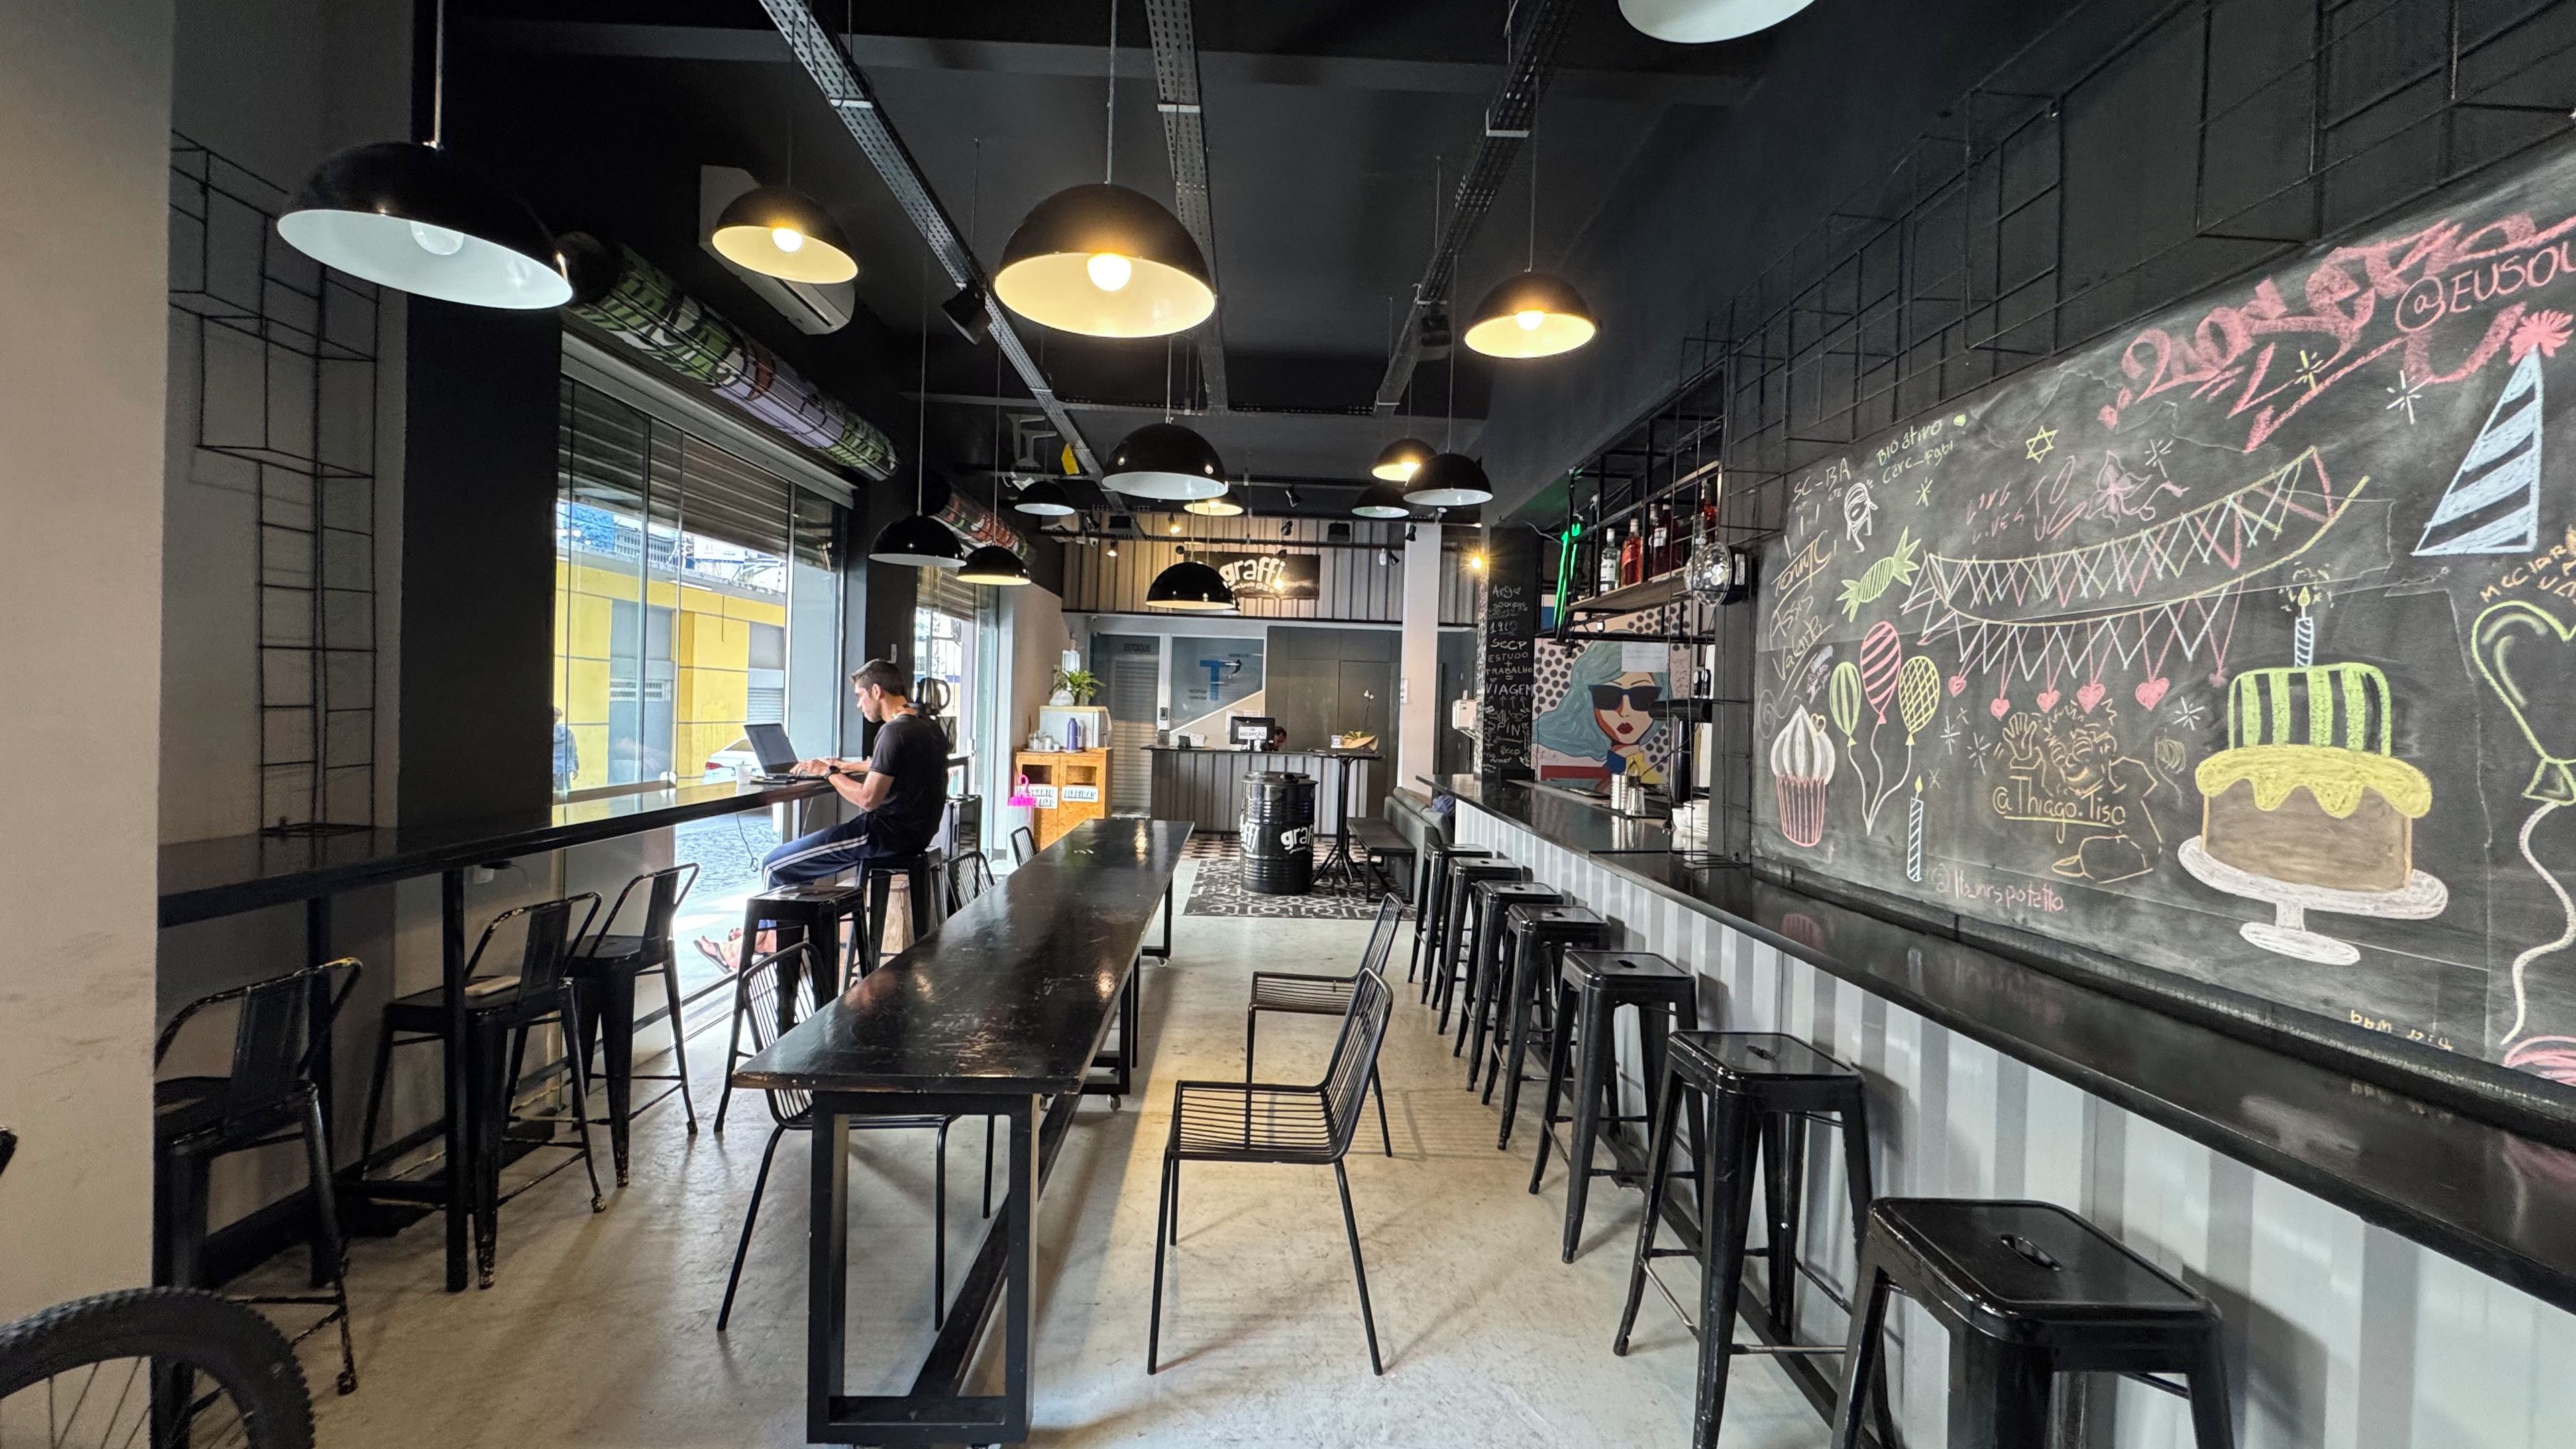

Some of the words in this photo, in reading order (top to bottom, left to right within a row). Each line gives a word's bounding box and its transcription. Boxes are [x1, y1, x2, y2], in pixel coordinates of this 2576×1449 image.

[1219, 556, 1285, 586] graffi
[1490, 638, 1527, 651] SCCP
[1488, 651, 1529, 663] ESTUDO
[1485, 665, 1533, 676] TRABALHO
[1485, 683, 1534, 698] VIAGEM
